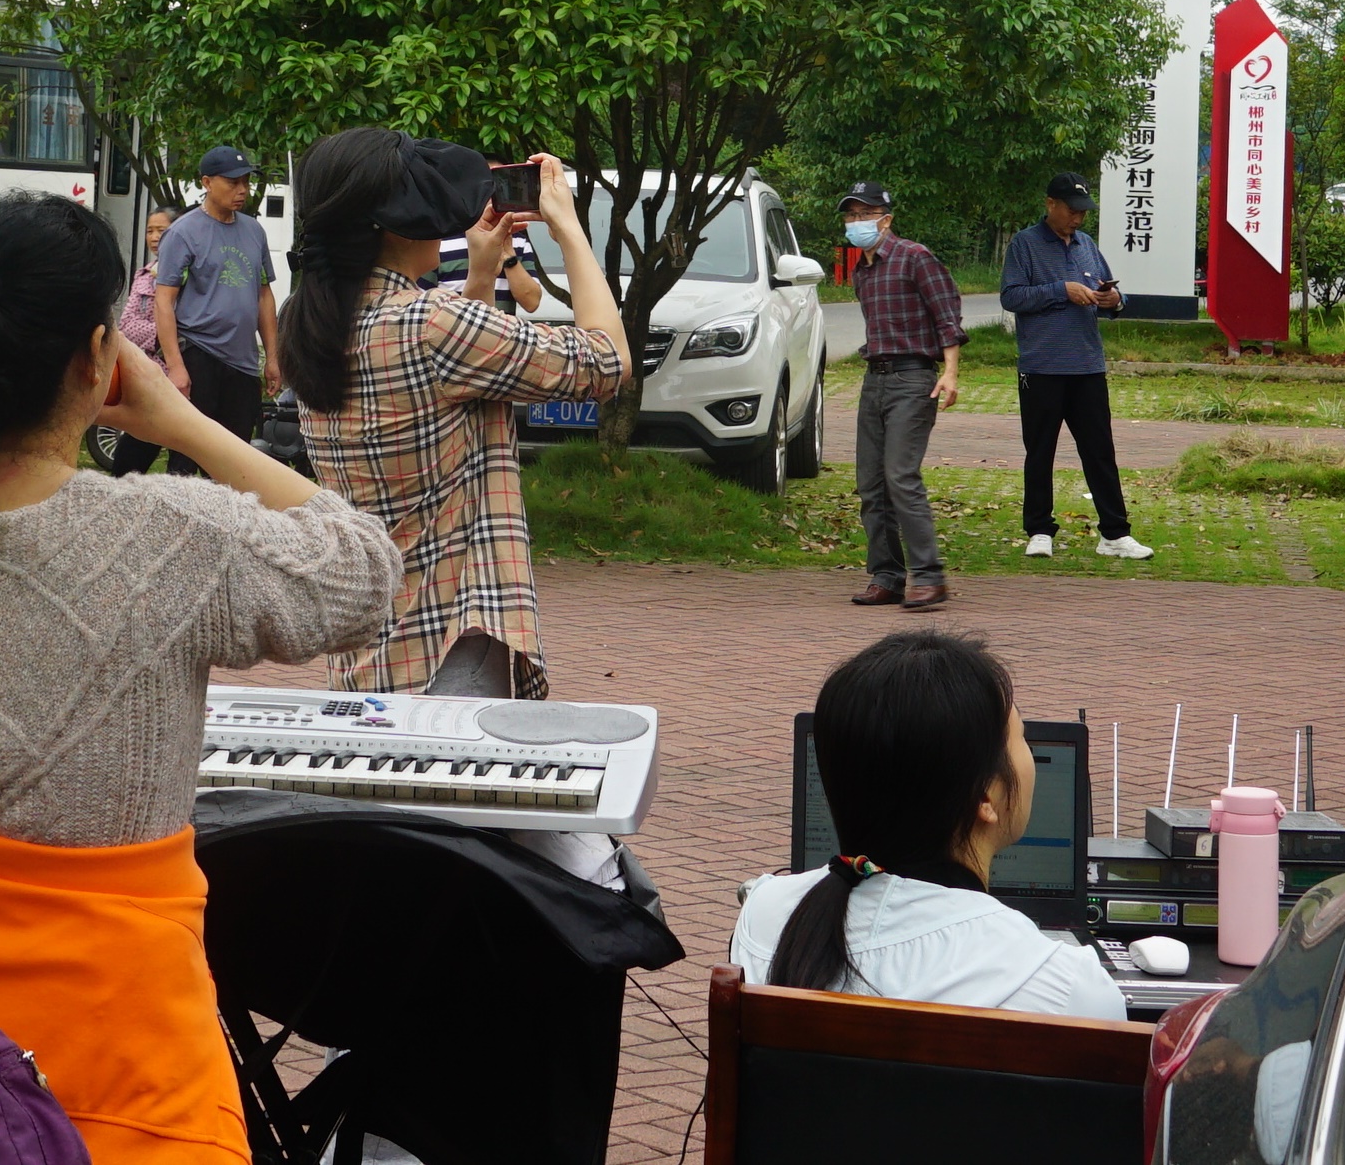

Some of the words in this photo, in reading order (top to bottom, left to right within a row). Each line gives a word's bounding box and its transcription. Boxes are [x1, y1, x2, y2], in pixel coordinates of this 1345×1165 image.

[1244, 105, 1265, 234] 郴州市同心美丽乡村
